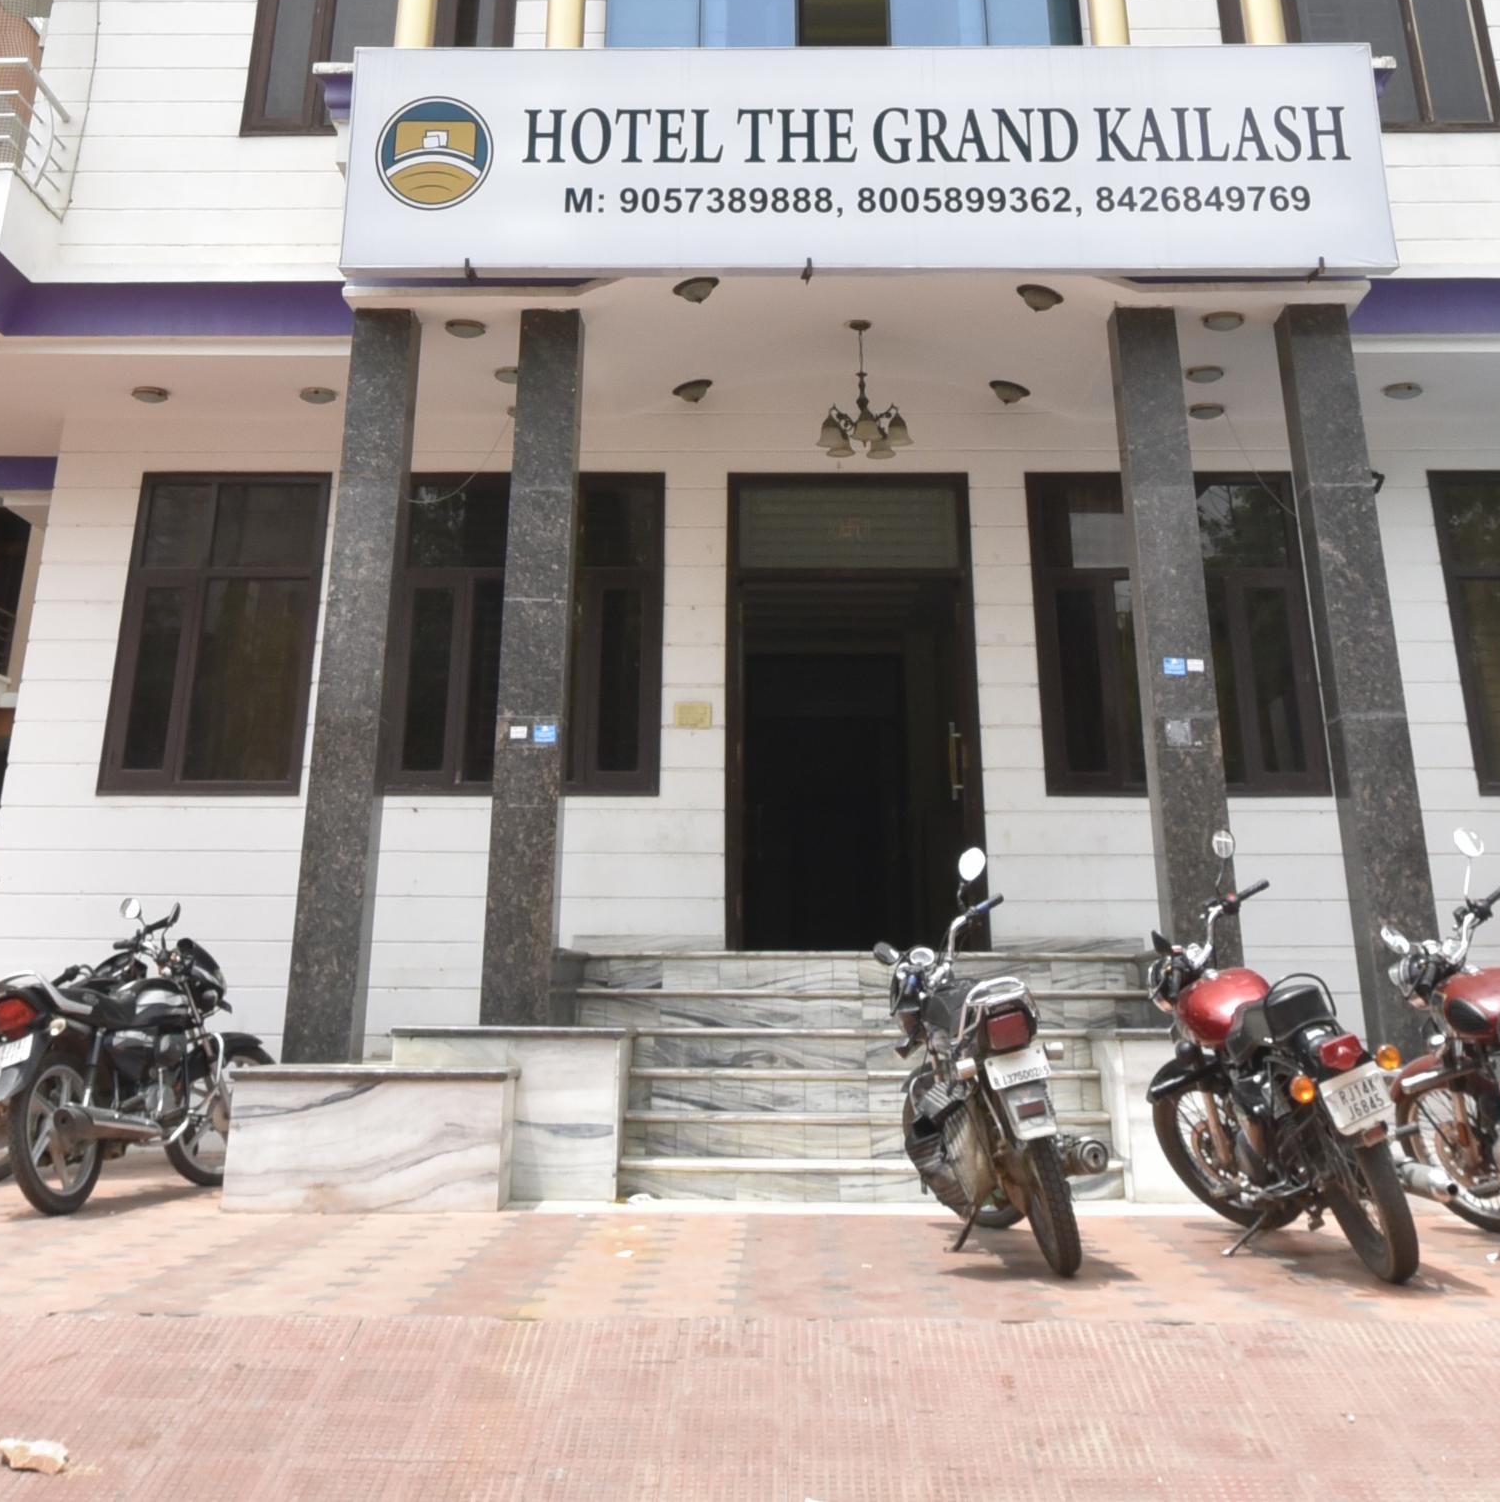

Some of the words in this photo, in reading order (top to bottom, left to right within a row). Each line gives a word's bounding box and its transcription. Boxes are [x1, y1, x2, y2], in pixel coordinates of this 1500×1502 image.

[522, 107, 724, 165] HOTEL
[736, 108, 858, 163] THE
[872, 107, 1079, 165] GRAND
[1094, 105, 1352, 163] KAILASH
[564, 187, 605, 214] M:
[619, 186, 843, 218] 9057389888,
[857, 185, 1082, 217] 8005899362,
[1096, 185, 1311, 214] 8426849769
